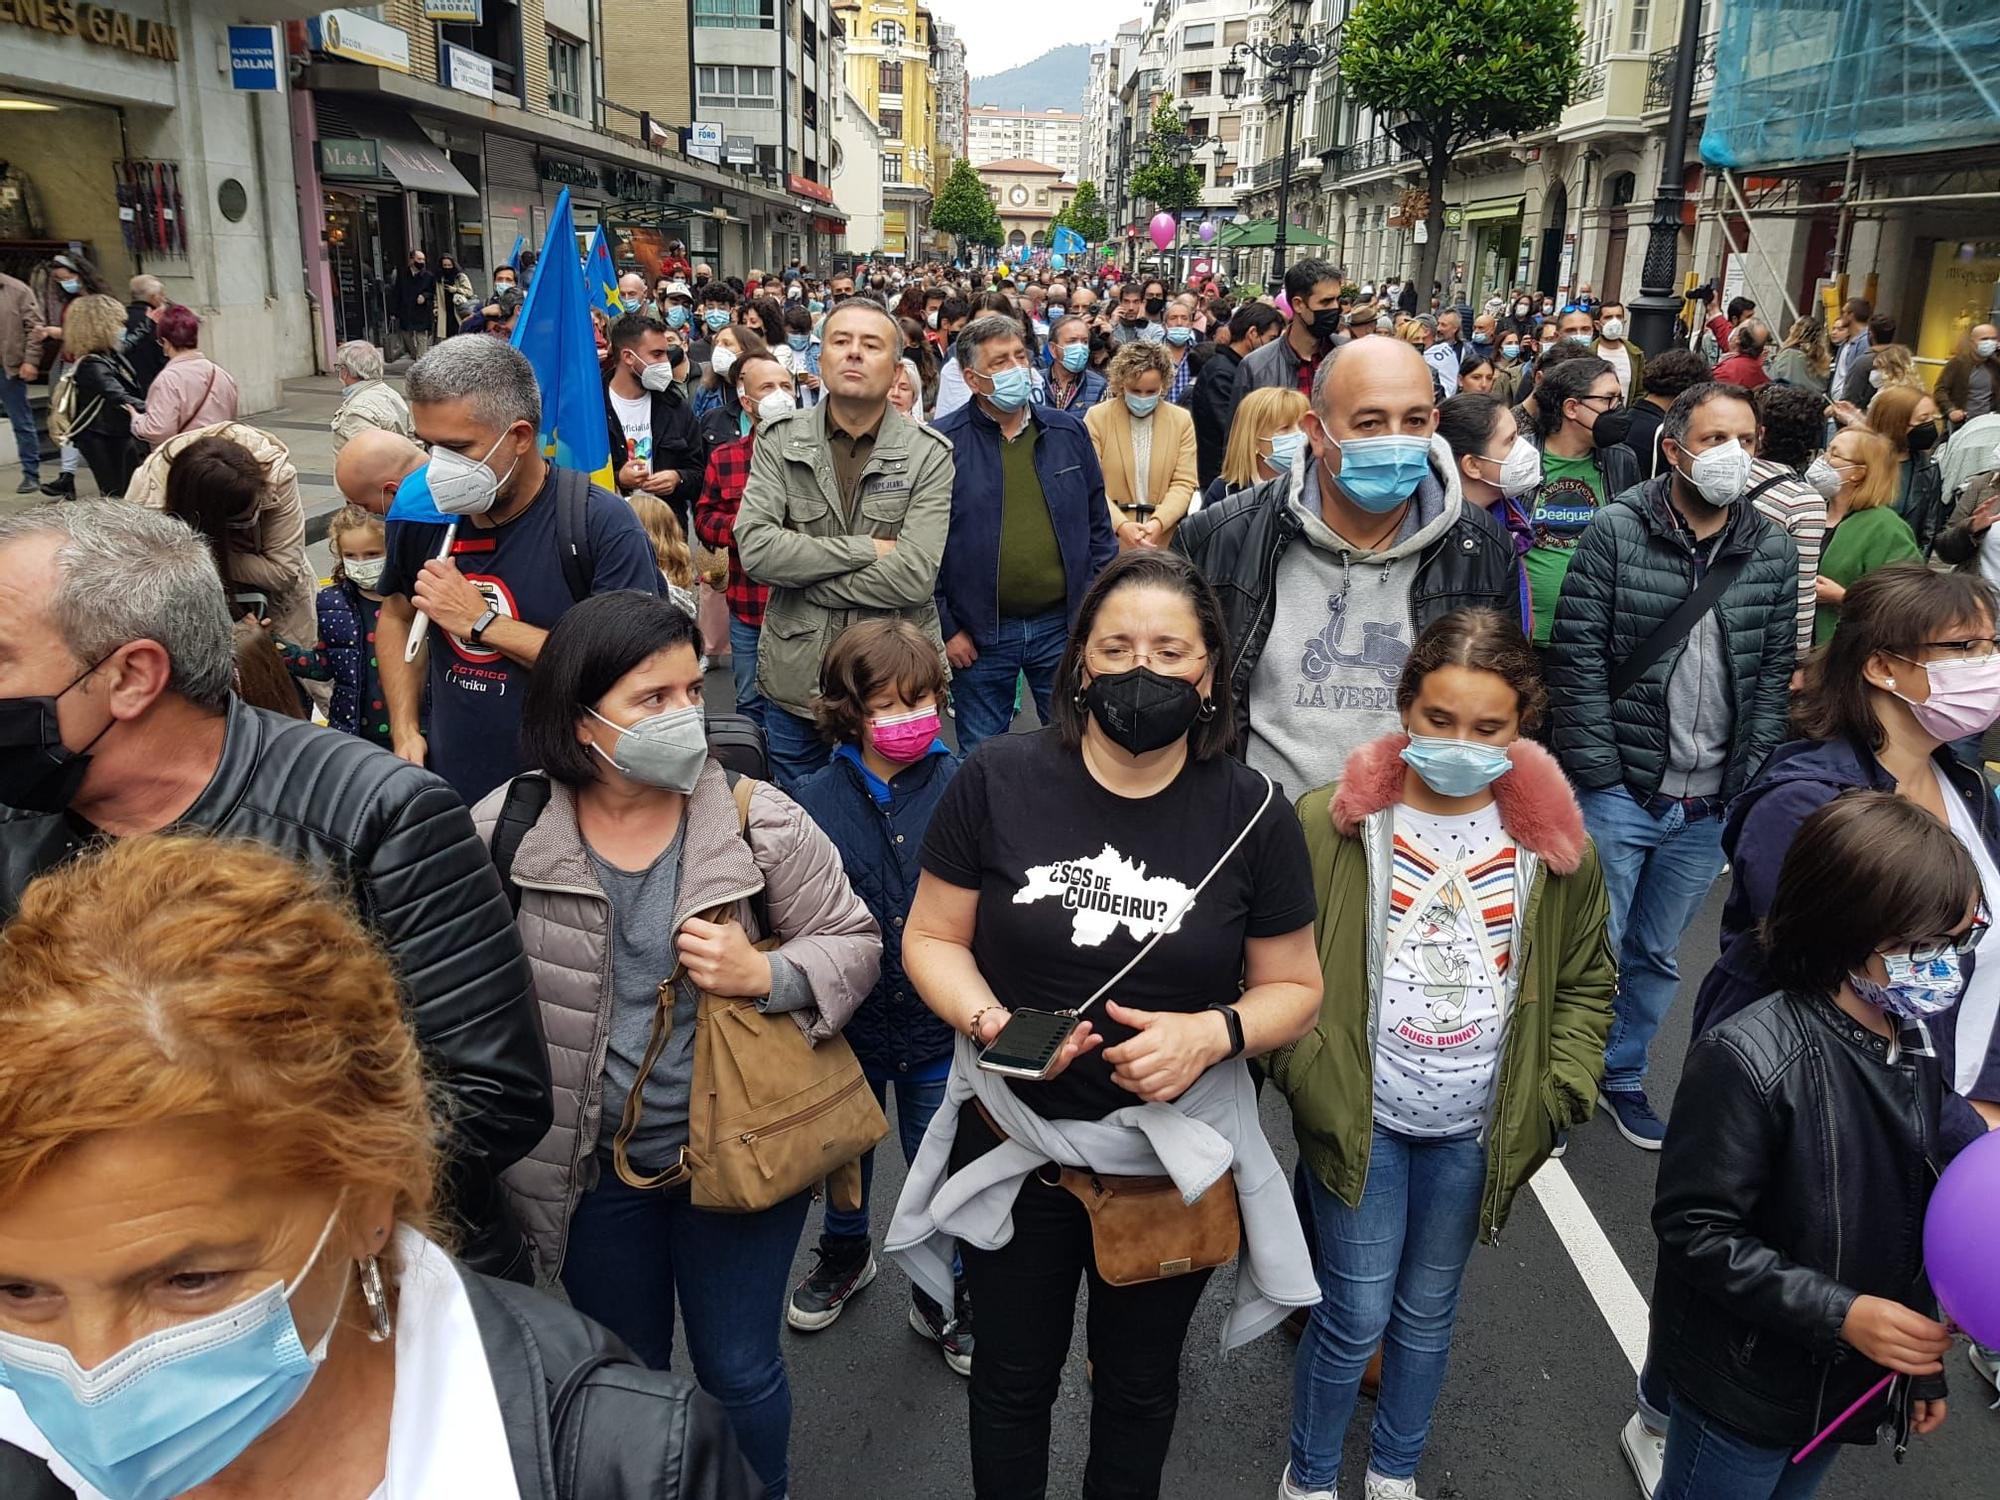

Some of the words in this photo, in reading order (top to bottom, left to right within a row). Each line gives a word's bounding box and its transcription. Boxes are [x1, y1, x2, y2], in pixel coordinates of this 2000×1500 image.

[426, 3, 475, 11] LABORAL
[88, 5, 179, 60] GALAN
[232, 59, 274, 70] GALAN
[698, 131, 716, 139] FORO
[1535, 508, 1594, 523] Desigual
[1295, 684, 1326, 707] LA
[1050, 863, 1093, 888] ¿SOS
[1094, 876, 1112, 891] DE
[1064, 886, 1168, 922] CUIDEIRU?
[1400, 1025, 1433, 1045] BUGS
[1437, 1025, 1477, 1046] BUNNY
